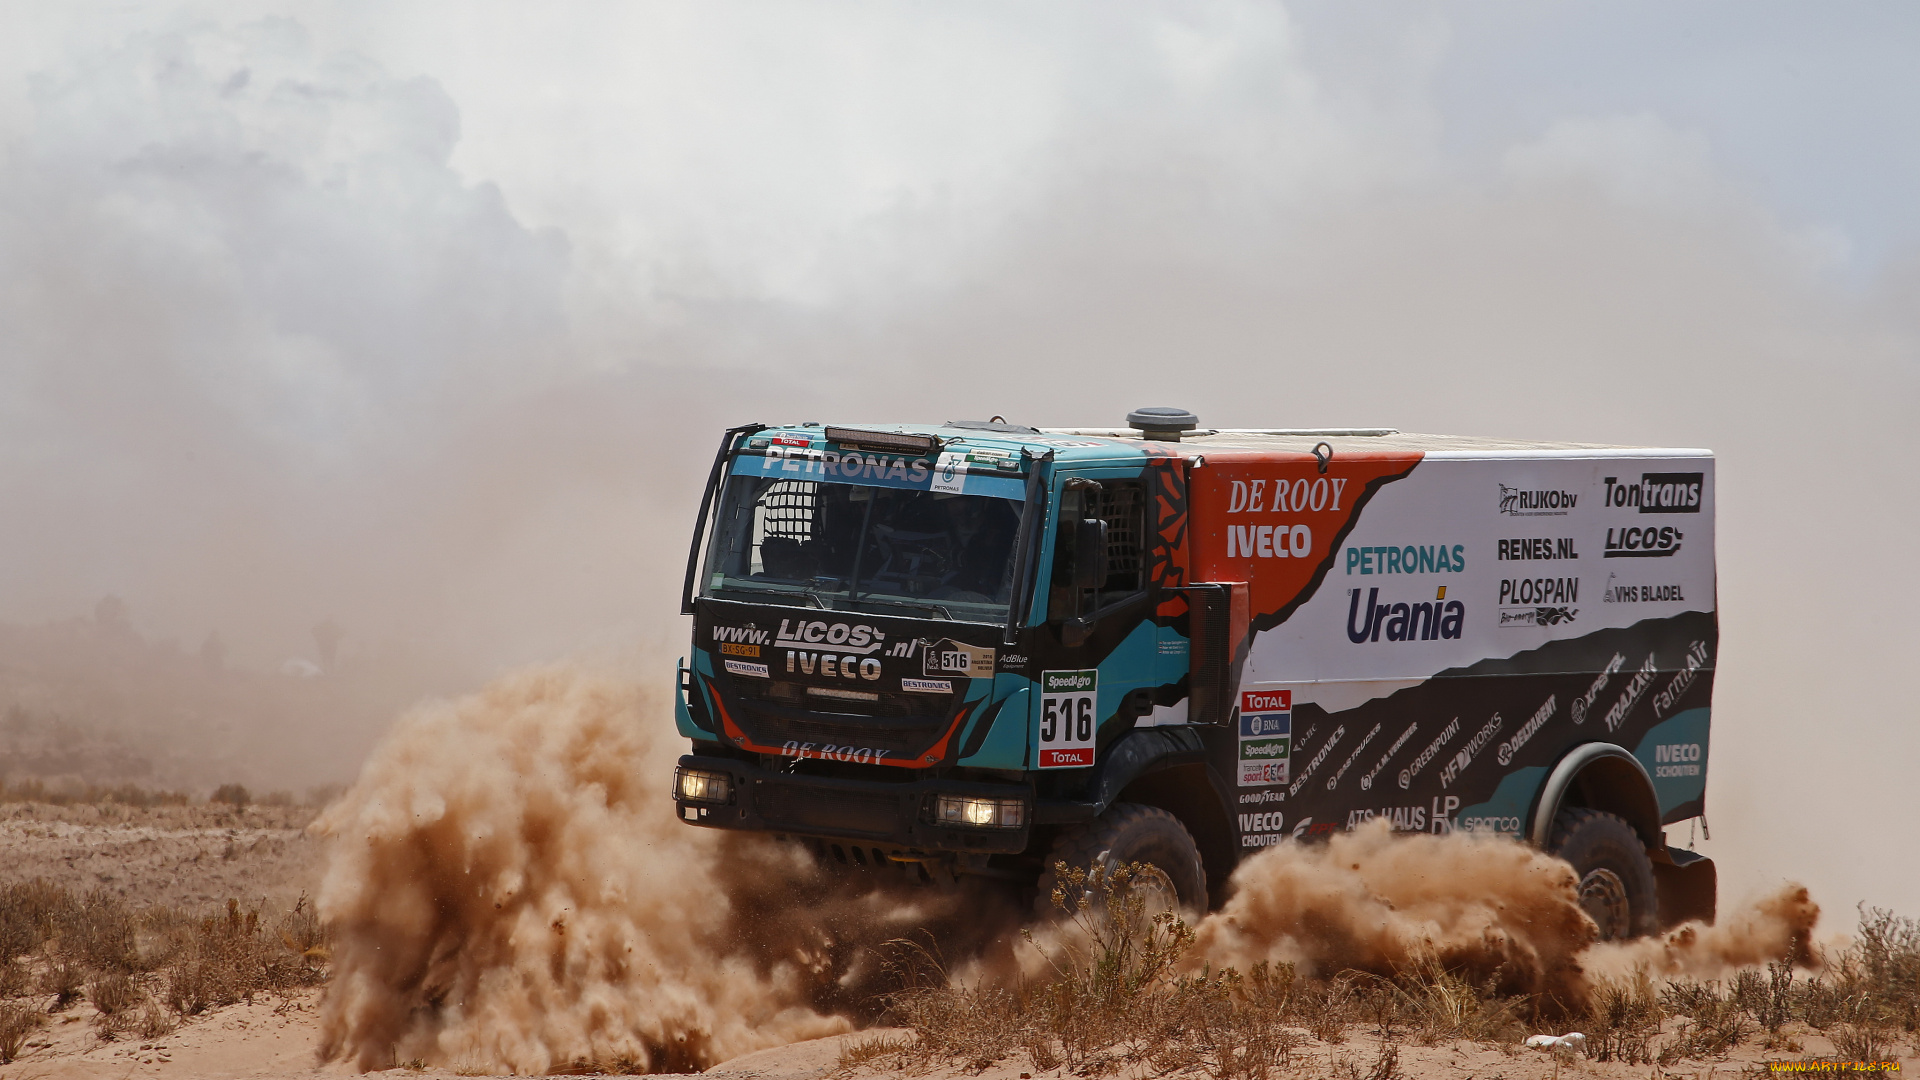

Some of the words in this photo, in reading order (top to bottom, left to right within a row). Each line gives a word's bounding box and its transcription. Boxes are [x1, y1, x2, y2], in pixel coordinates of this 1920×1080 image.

[763, 445, 930, 483] PETRONAS
[1227, 479, 1266, 513] DE
[1270, 477, 1348, 512] ROOY
[1604, 476, 1699, 508] Tontrans
[1227, 524, 1312, 558] IVECO
[1498, 538, 1579, 560] RENES.NL
[1605, 526, 1674, 549] LICOS
[1346, 544, 1466, 575] PETRONAS
[1499, 577, 1579, 605] PLOSPAN
[1615, 586, 1638, 602] VHS
[1641, 585, 1684, 602] BLADEL
[1346, 585, 1465, 644] Urania
[776, 618, 873, 647] LICOS
[723, 644, 757, 655] BX-SG-91
[943, 653, 967, 668] 516
[999, 654, 1029, 663] AdBlue
[726, 661, 768, 674] BESTRONICS
[786, 650, 882, 680] IVECO
[903, 680, 951, 690] BESTRONICS
[1048, 675, 1091, 689] SpeedAgro
[1246, 694, 1286, 709] TOTAL
[1041, 697, 1092, 742] 516
[1263, 719, 1280, 731] BNA
[1511, 693, 1557, 752] DELTARENT
[781, 740, 817, 759] DE
[820, 743, 892, 766] ROOY
[1051, 751, 1083, 763] TOTAL
[1410, 716, 1460, 776] GREENPOINT
[1440, 758, 1459, 789] HF
[1468, 711, 1502, 754] WORKS
[1656, 743, 1701, 763] IVECO
[1289, 724, 1345, 797] BESTRONICS
[1240, 790, 1285, 804] GOODYEAR
[1238, 811, 1284, 832] IVECO
